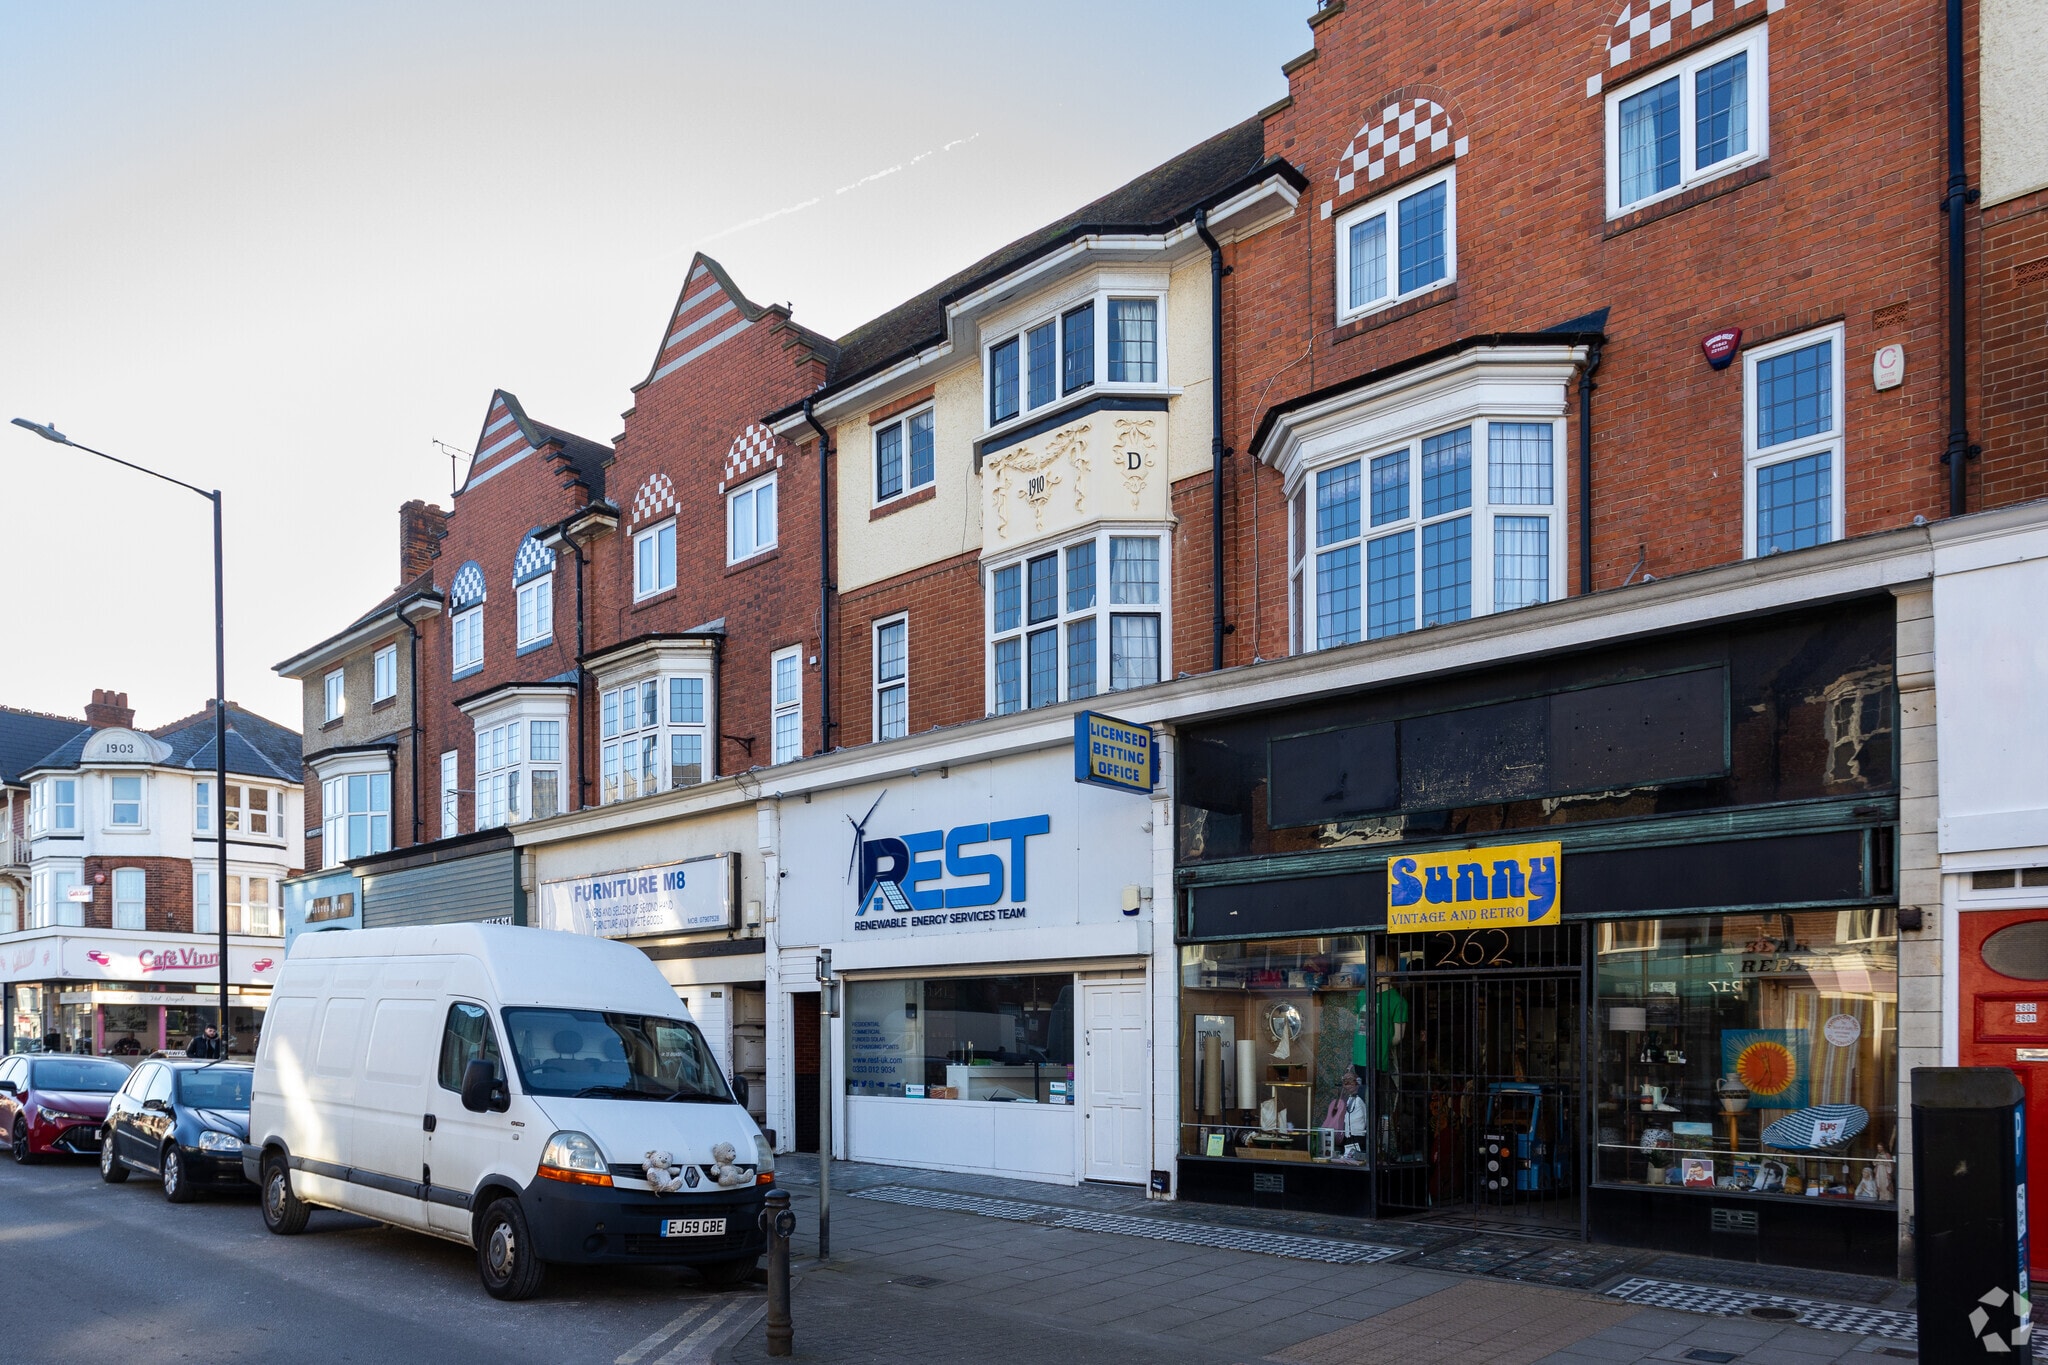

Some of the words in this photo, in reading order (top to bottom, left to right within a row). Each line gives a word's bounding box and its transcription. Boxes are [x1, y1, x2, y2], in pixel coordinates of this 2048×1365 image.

[1127, 452, 1142, 470] D
[1028, 475, 1045, 498] 1910
[1090, 722, 1147, 748] LICENSED
[106, 743, 134, 754] 1903
[1093, 742, 1145, 765] BETTING
[1098, 761, 1140, 782] OFFICE
[855, 814, 1050, 917] REST
[574, 874, 658, 902] FURNITURE
[663, 870, 686, 891] M8
[1391, 856, 1557, 923] Sunny
[612, 905, 632, 917] SELLERS
[632, 903, 639, 915] OF
[854, 917, 907, 931] RENEWABLE
[911, 914, 948, 927] ENERGY
[950, 910, 996, 924] SERVICES
[997, 907, 1026, 920] TEAM
[1391, 911, 1446, 925] VINTAGE
[1450, 909, 1477, 921] AND
[1480, 907, 1525, 920] RETRO
[138, 949, 178, 971] Café
[179, 947, 221, 966] Vinn
[1435, 928, 1513, 967] 262
[868, 1066, 879, 1074] 012
[668, 1221, 700, 1234] EJ59
[702, 1220, 724, 1233] GBE
